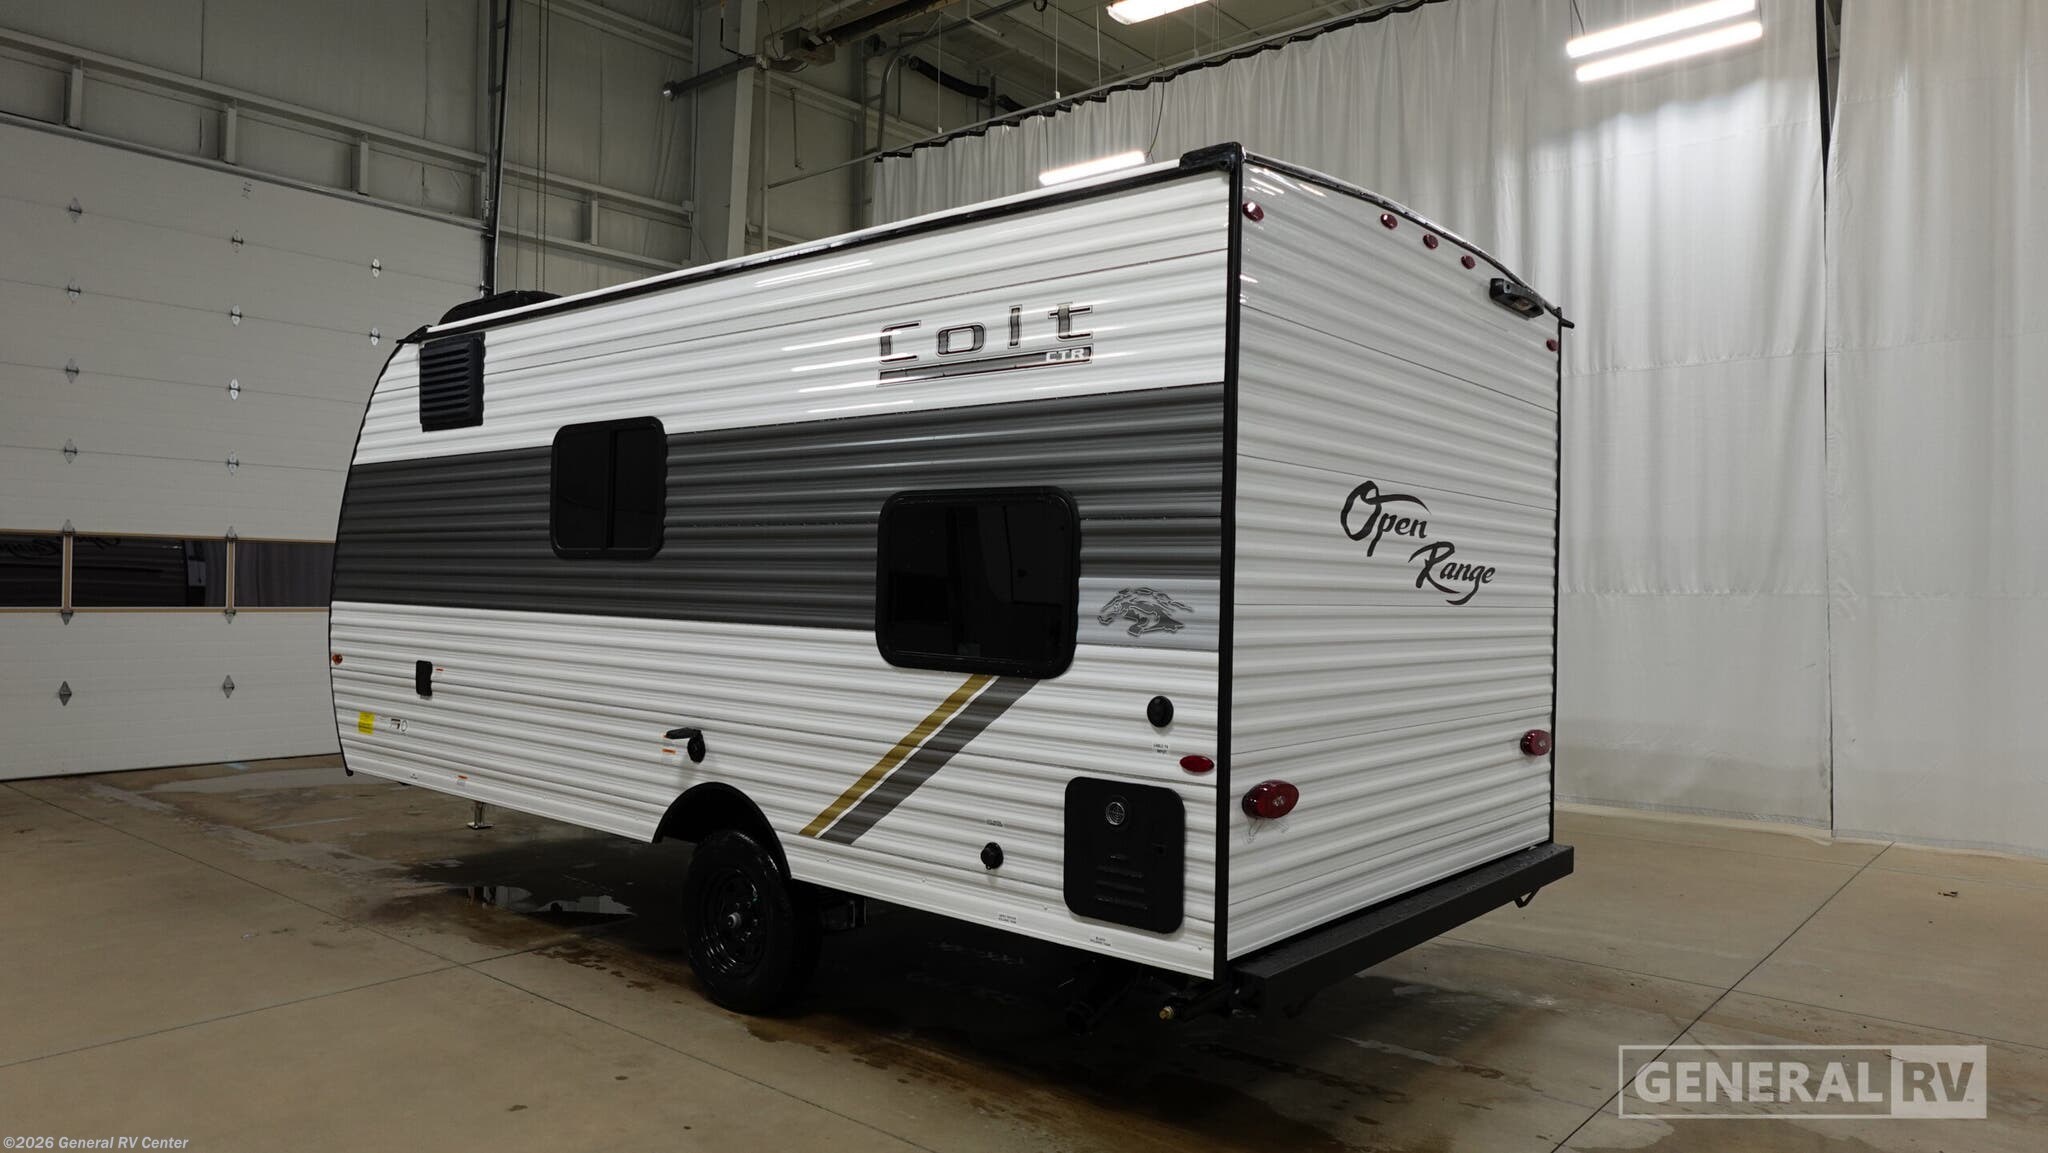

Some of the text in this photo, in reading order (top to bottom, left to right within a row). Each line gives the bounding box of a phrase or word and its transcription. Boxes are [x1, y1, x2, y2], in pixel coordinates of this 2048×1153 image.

[879, 301, 1093, 365] Colt
[1340, 480, 1431, 557] Open
[1408, 541, 1496, 605] Range
